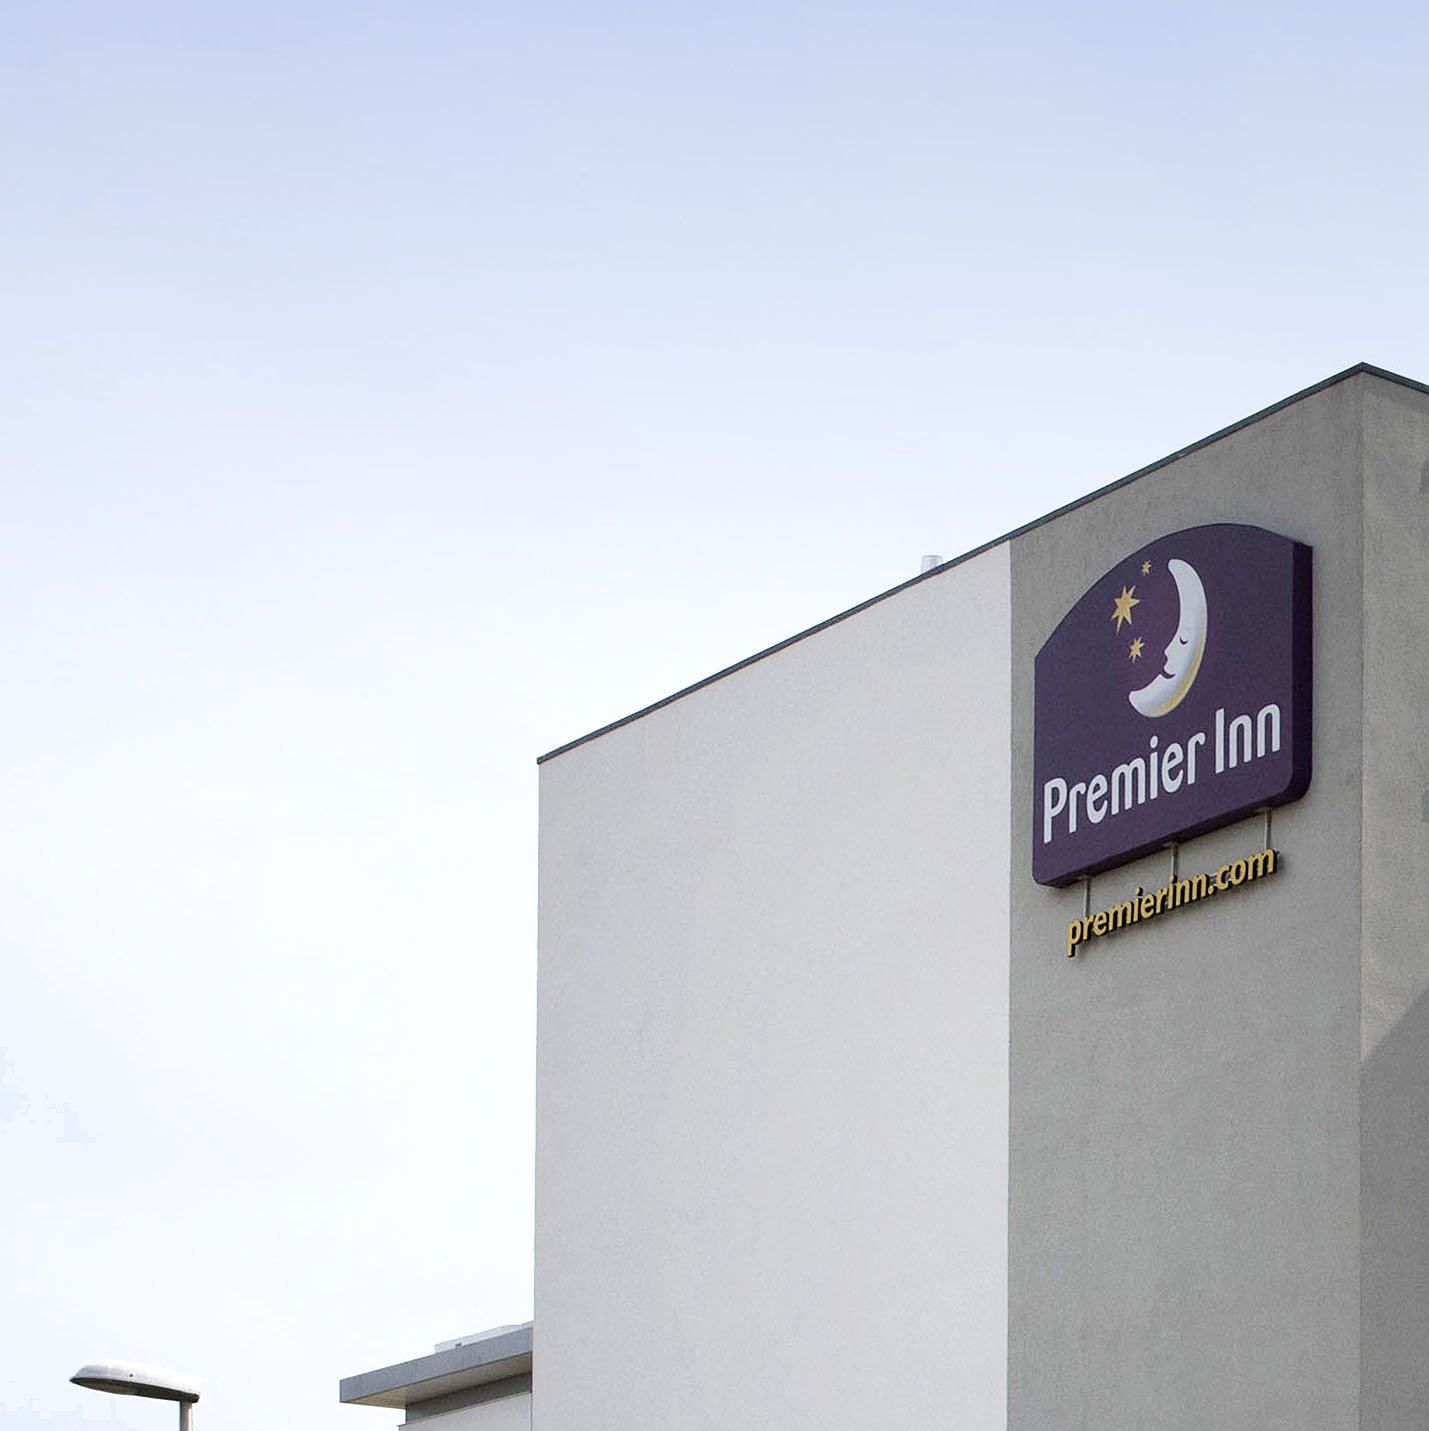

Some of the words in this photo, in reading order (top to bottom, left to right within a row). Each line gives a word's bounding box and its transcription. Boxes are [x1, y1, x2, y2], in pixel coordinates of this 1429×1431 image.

[1043, 732, 1206, 845] Premier
[1214, 702, 1282, 774] Inn
[1066, 847, 1279, 957] premierinn.com
